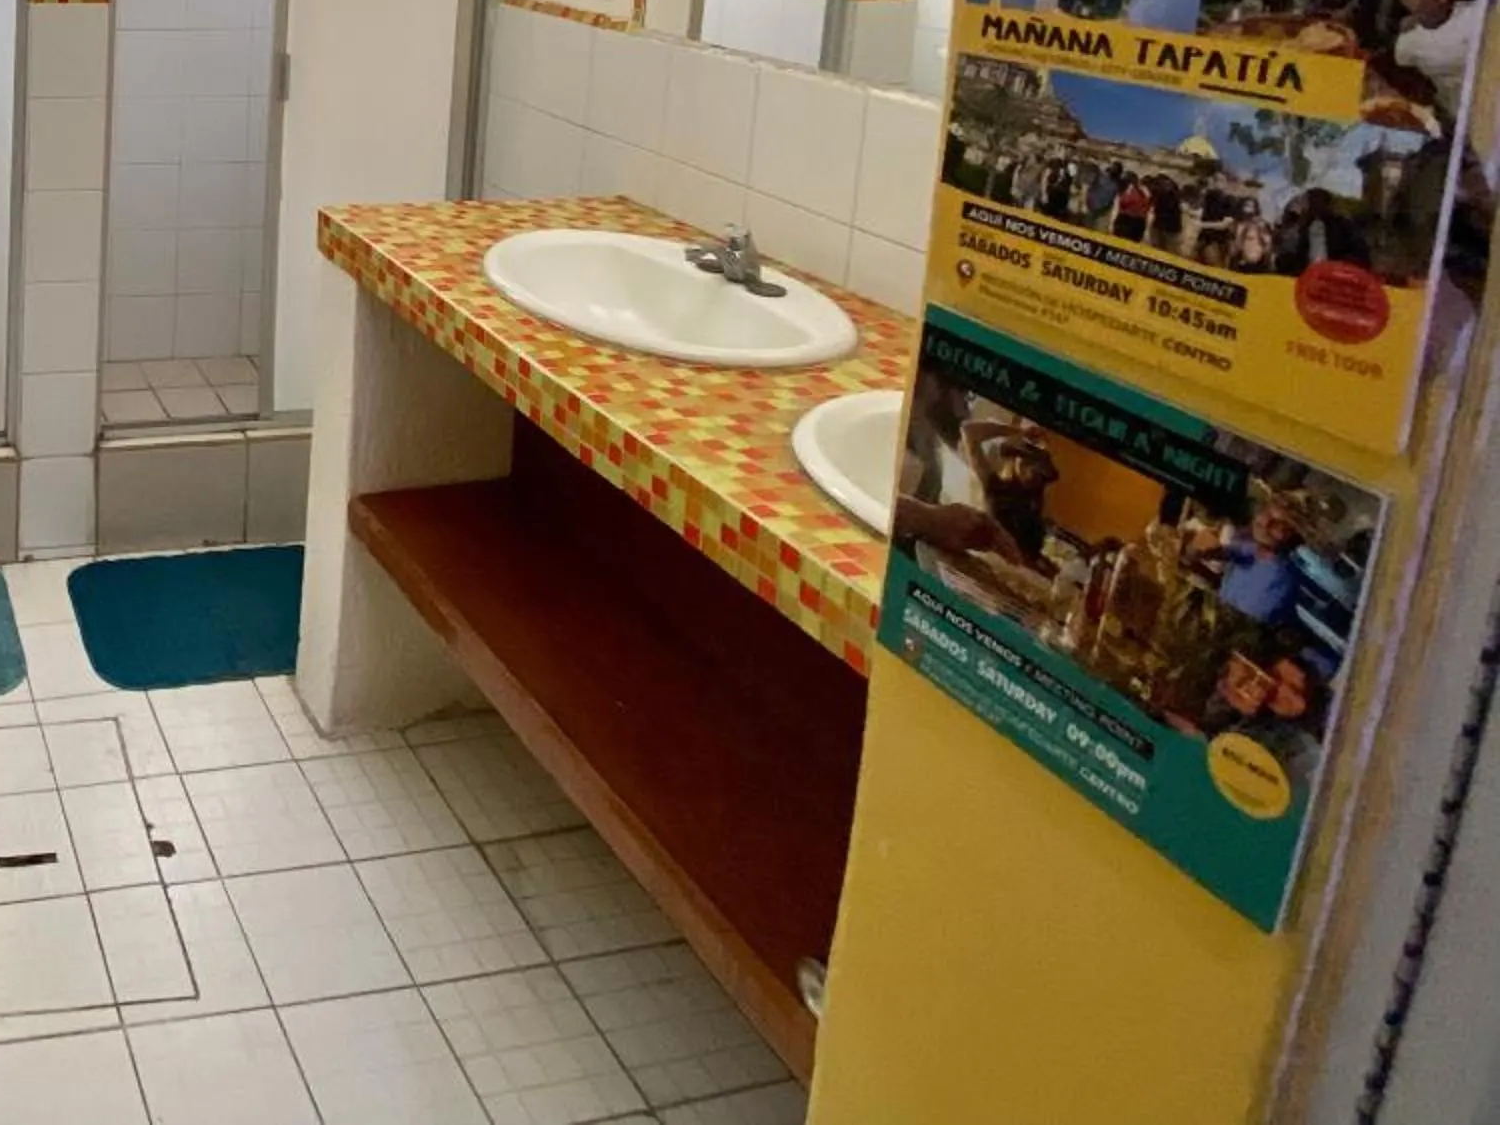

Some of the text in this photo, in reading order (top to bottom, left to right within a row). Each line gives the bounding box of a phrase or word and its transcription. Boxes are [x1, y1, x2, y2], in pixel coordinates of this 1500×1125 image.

[981, 13, 1113, 59] MAÑANA
[1134, 36, 1303, 93] TAPATÍA
[1005, 218, 1036, 238] NOS
[1039, 226, 1093, 256] VEMOS
[1105, 250, 1178, 283] MEETING
[1180, 273, 1235, 299] POINT
[1041, 260, 1133, 304] SATURDAY
[1147, 296, 1238, 340] 10:45am
[945, 608, 974, 635] NOS
